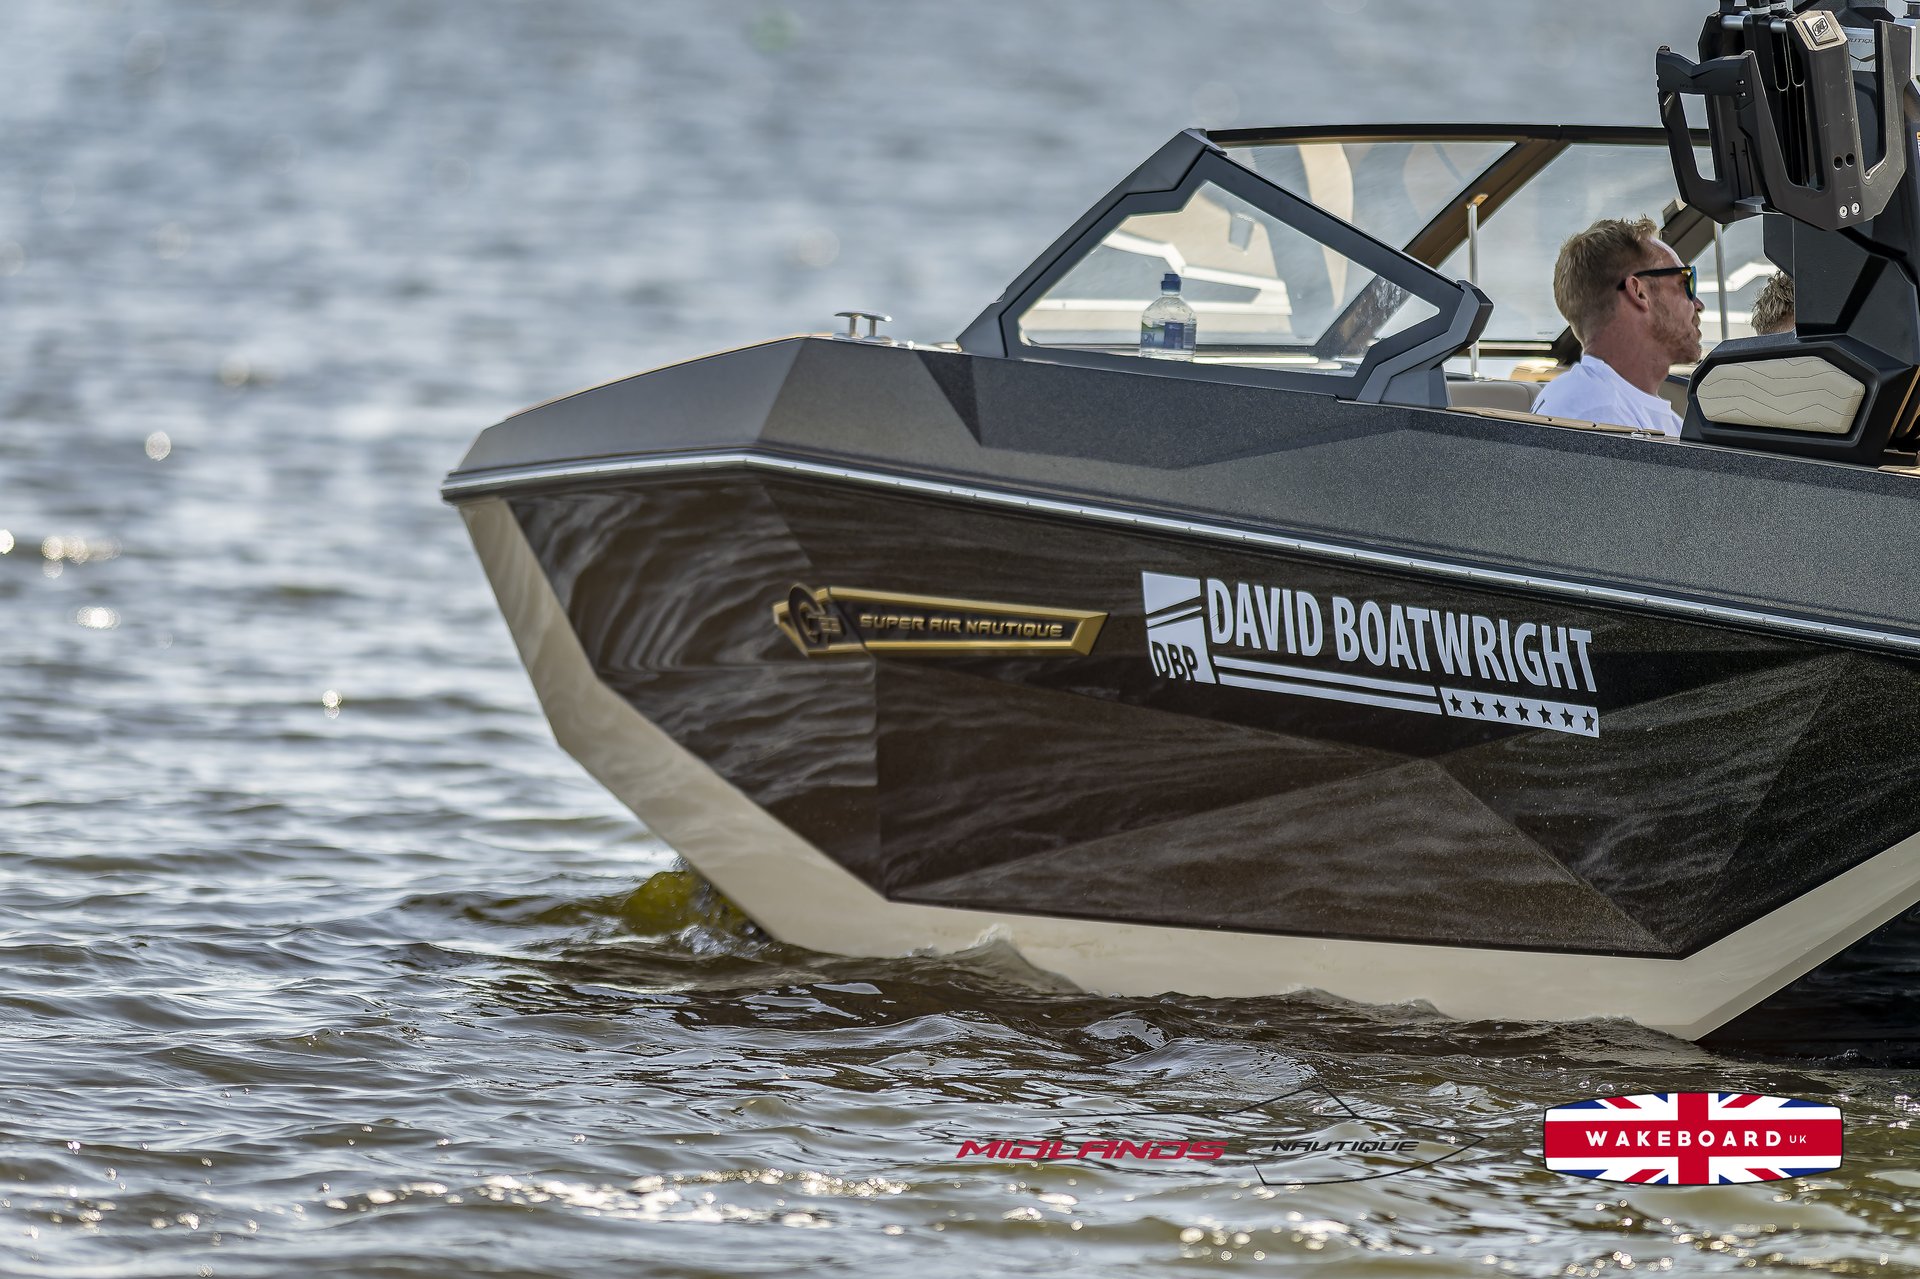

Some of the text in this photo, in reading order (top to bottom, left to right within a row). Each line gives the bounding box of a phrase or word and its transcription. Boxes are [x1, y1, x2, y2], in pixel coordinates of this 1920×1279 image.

[860, 614, 1063, 637] SUPER AIR NAUTIQUE
[1207, 578, 1598, 692] DAVID BOATWRIGHT
[1151, 641, 1199, 682] DBP
